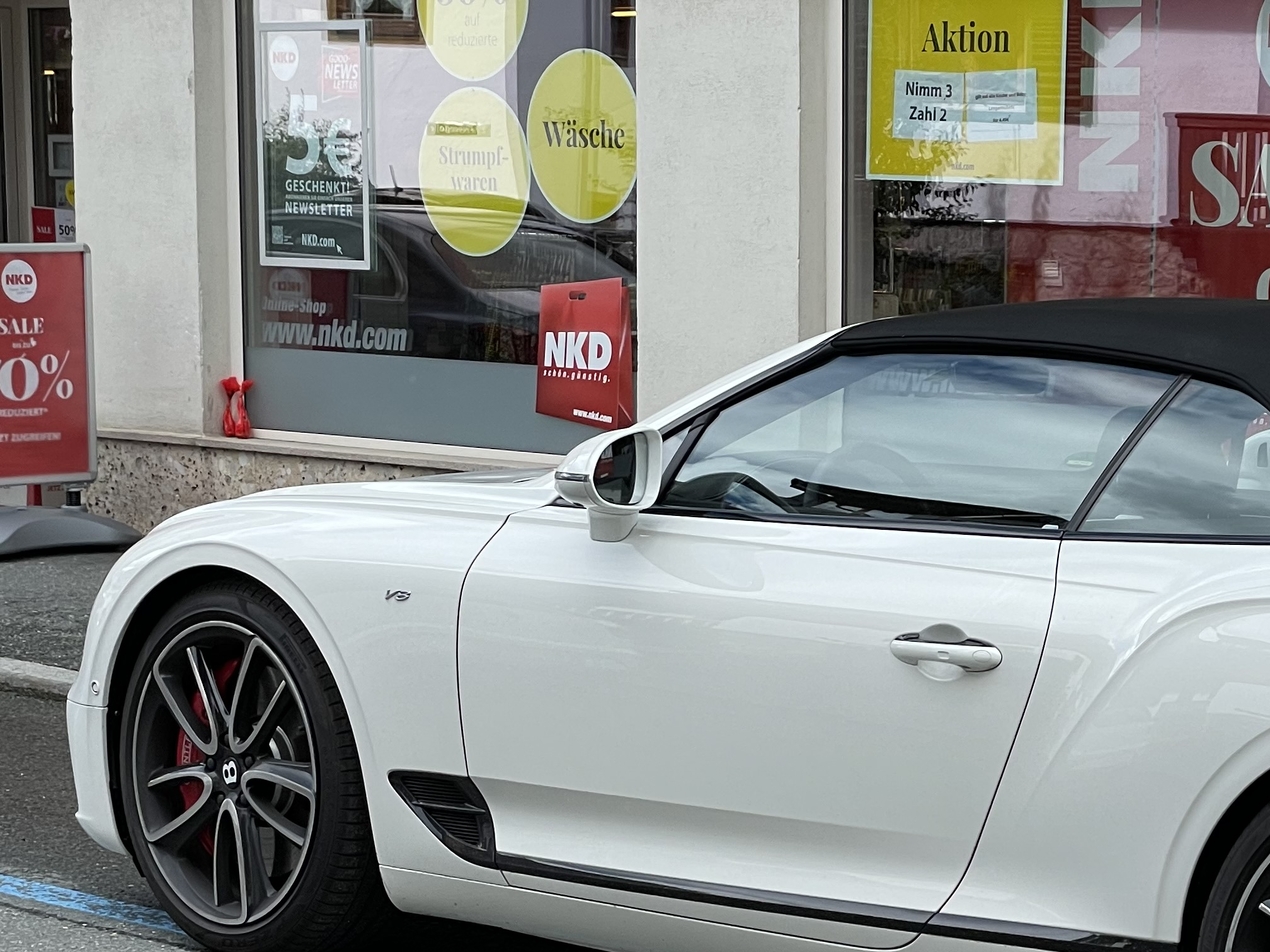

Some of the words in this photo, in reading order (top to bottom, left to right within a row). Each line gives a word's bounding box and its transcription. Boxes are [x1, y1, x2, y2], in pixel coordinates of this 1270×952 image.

[464, 12, 480, 26] auf
[447, 32, 498, 46] reduzierte
[921, 20, 1010, 53] Aktion
[272, 51, 296, 63] NKD
[324, 63, 359, 79] NEWS
[333, 80, 358, 90] LETTER
[905, 82, 942, 97] Nimm
[945, 84, 953, 98] 3
[1078, 0, 1142, 192] NK
[909, 106, 937, 121] Zahl
[939, 109, 947, 122] 2
[285, 94, 352, 177] 5€
[543, 119, 625, 149] Wäsche
[438, 145, 509, 170] Strumpf-
[285, 179, 350, 194] GESCHENKT!
[451, 176, 497, 192] waren
[285, 201, 353, 217] NEWSLETTER
[301, 233, 336, 247] NKD.com
[5, 274, 33, 285] NKD
[0, 317, 44, 335] SALE
[262, 318, 408, 352] www.nkd.com
[543, 331, 613, 370] NKD
[0, 350, 74, 402] 0%
[572, 408, 613, 423] www.nkd.com
[385, 589, 411, 601] V8
